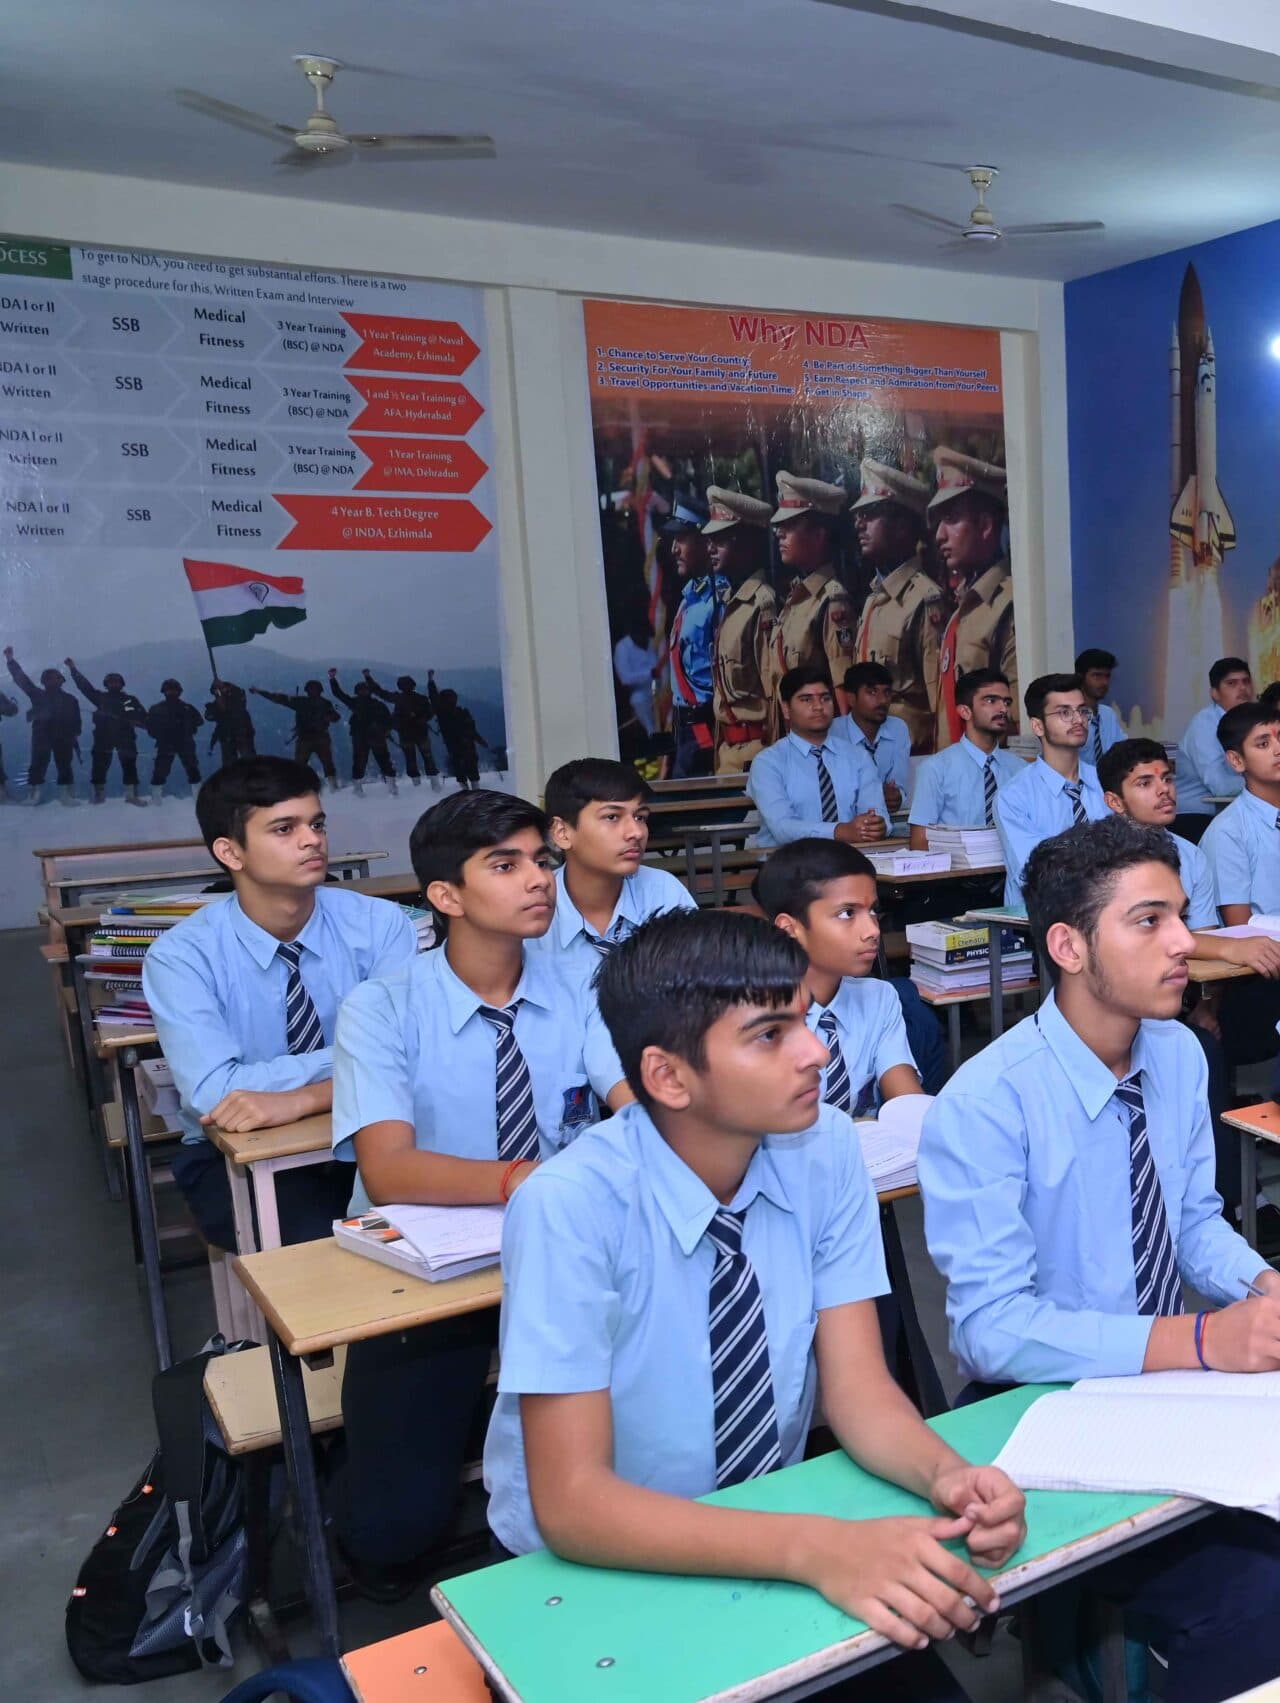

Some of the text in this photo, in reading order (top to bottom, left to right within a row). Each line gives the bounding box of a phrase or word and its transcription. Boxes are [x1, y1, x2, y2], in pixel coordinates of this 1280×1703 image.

[80, 248, 94, 261] To
[96, 251, 115, 266] get
[116, 252, 128, 264] to
[131, 254, 162, 270] NDA,
[163, 260, 184, 272] you
[187, 261, 213, 272] need
[216, 262, 226, 274] to
[228, 266, 244, 278] get
[246, 266, 302, 282] substantial
[304, 272, 338, 285] efforts.
[340, 274, 368, 288] There
[370, 278, 378, 288] is
[387, 282, 407, 292] two
[82, 274, 354, 308] stage procedure for this, Written Exam and Interview
[30, 302, 45, 312] or
[194, 307, 246, 324] Medical
[0, 320, 50, 336] Written
[112, 316, 141, 332] SSB
[285, 321, 346, 338] Year Training
[728, 314, 869, 351] Why NDA
[200, 332, 246, 348] Fitness
[282, 338, 345, 352] (BSC) NDA
[608, 348, 708, 364] Chance to Serve Your
[32, 366, 46, 376] or
[609, 363, 778, 380] Security For Your Family and Future
[115, 376, 144, 390] SSB
[200, 376, 252, 390] Medical
[610, 376, 768, 393] Travel Opportunities and Vacation
[2, 384, 52, 399] Written
[290, 388, 352, 404] Year Training
[206, 400, 251, 414] Fitness
[288, 405, 350, 418] (BSC) NDA
[0, 429, 52, 443] NDA or
[121, 442, 150, 458] SSB
[206, 438, 257, 452] Medical
[8, 452, 58, 466] Written
[296, 446, 356, 460] Year Training
[394, 450, 453, 464] Year Training
[211, 462, 256, 477] Fitness
[292, 463, 355, 476] (BSC) @ NDA
[6, 501, 60, 514] NDA or
[211, 499, 263, 514] Medical
[126, 508, 152, 522] SSB
[340, 507, 440, 522] Year Tech Degree
[16, 524, 65, 538] Written
[216, 524, 262, 537] Fitness
[388, 528, 433, 540] Ezhimala
